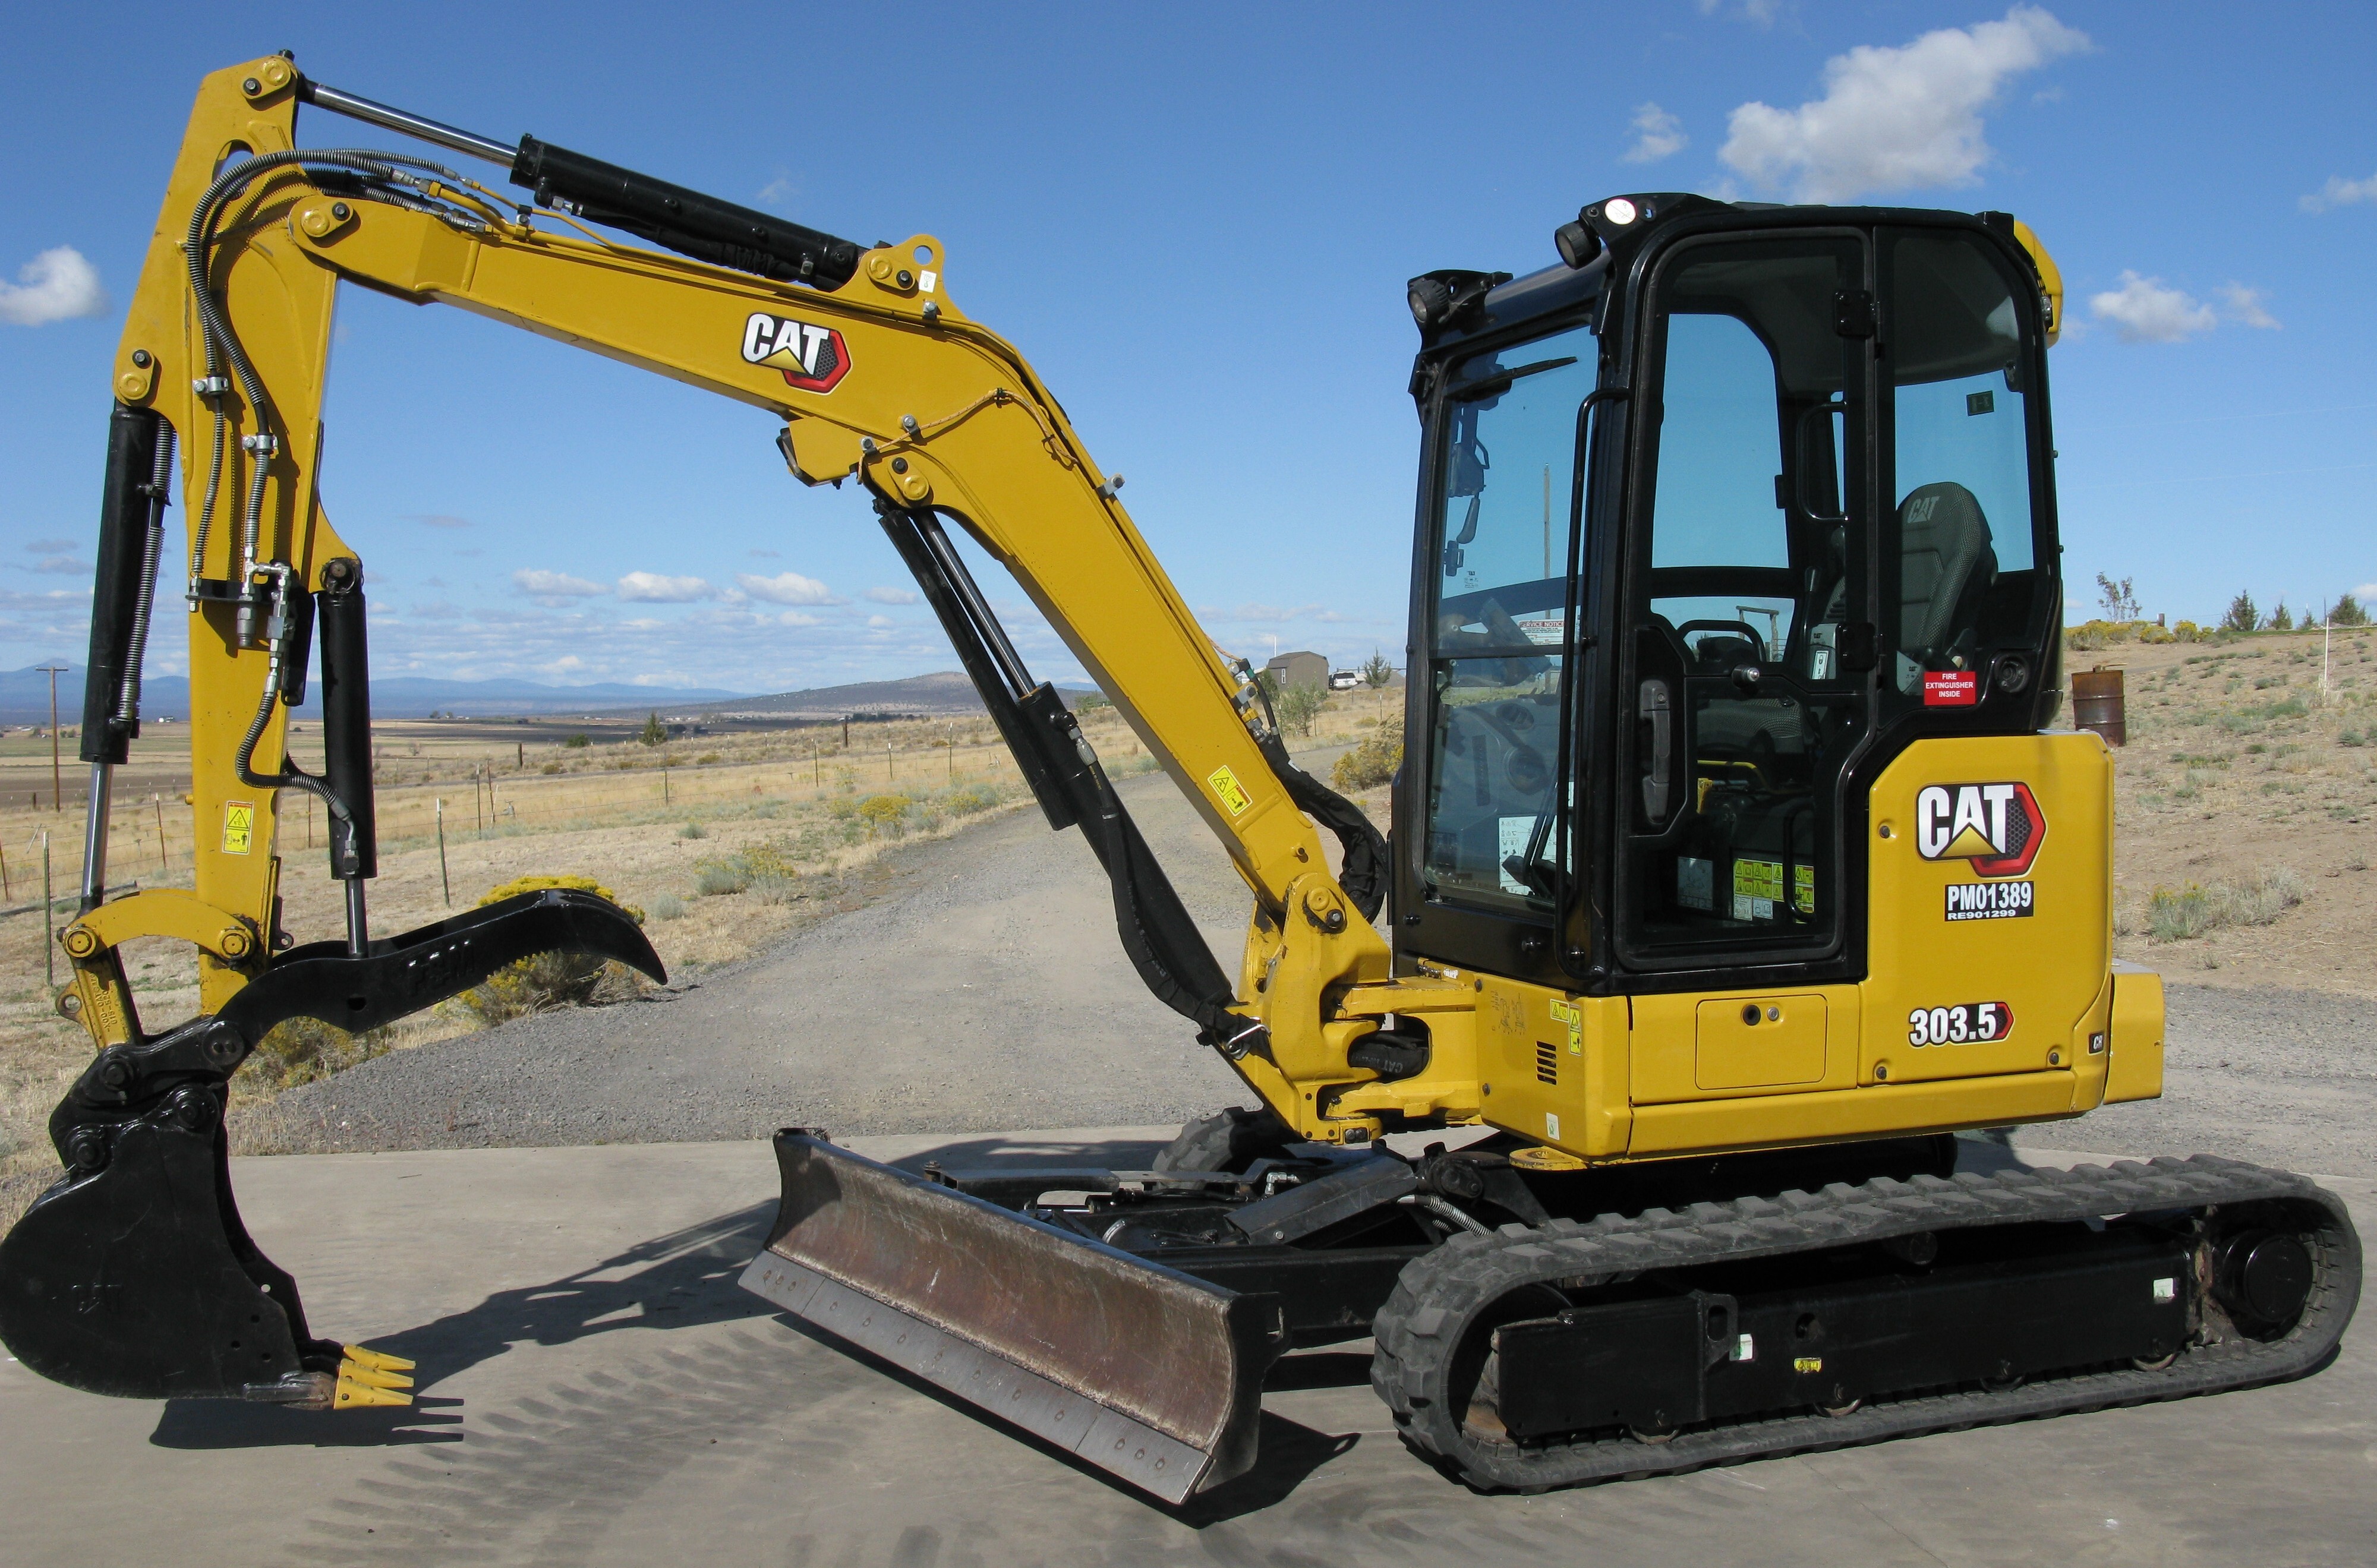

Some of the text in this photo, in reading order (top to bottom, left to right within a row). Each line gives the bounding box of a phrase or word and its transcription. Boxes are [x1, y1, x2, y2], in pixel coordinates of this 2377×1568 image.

[742, 313, 830, 376] CAT
[1907, 496, 1941, 524] CAT
[1918, 784, 2015, 858] CAT
[1947, 882, 2032, 911] PM01389
[1947, 909, 2016, 920] RE901299
[1909, 1003, 1997, 1046] 303.5
[2093, 1034, 2104, 1050] CR
[1383, 1059, 1404, 1074] CAT
